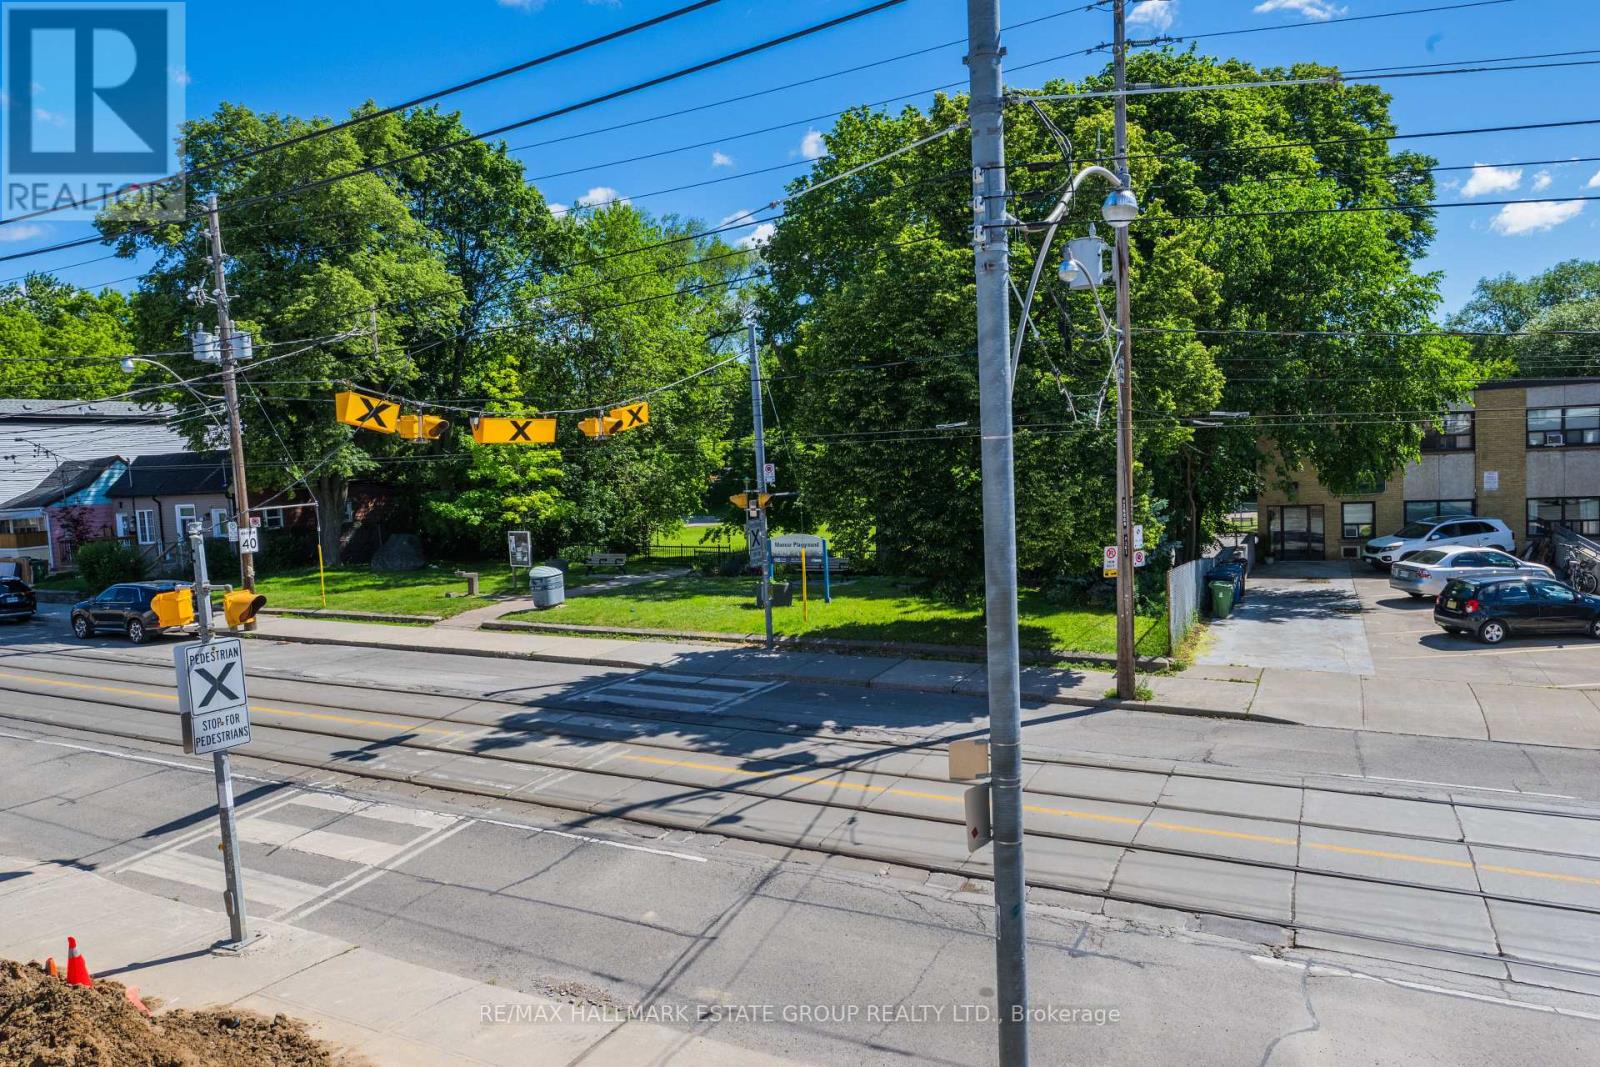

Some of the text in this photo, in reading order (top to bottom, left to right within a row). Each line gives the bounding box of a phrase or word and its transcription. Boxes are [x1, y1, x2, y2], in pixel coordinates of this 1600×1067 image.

[242, 538, 257, 549] 40
[189, 647, 239, 666] PEDESTRIAN
[202, 713, 240, 732] STOP FOR
[195, 726, 249, 748] PEDESTRIANS
